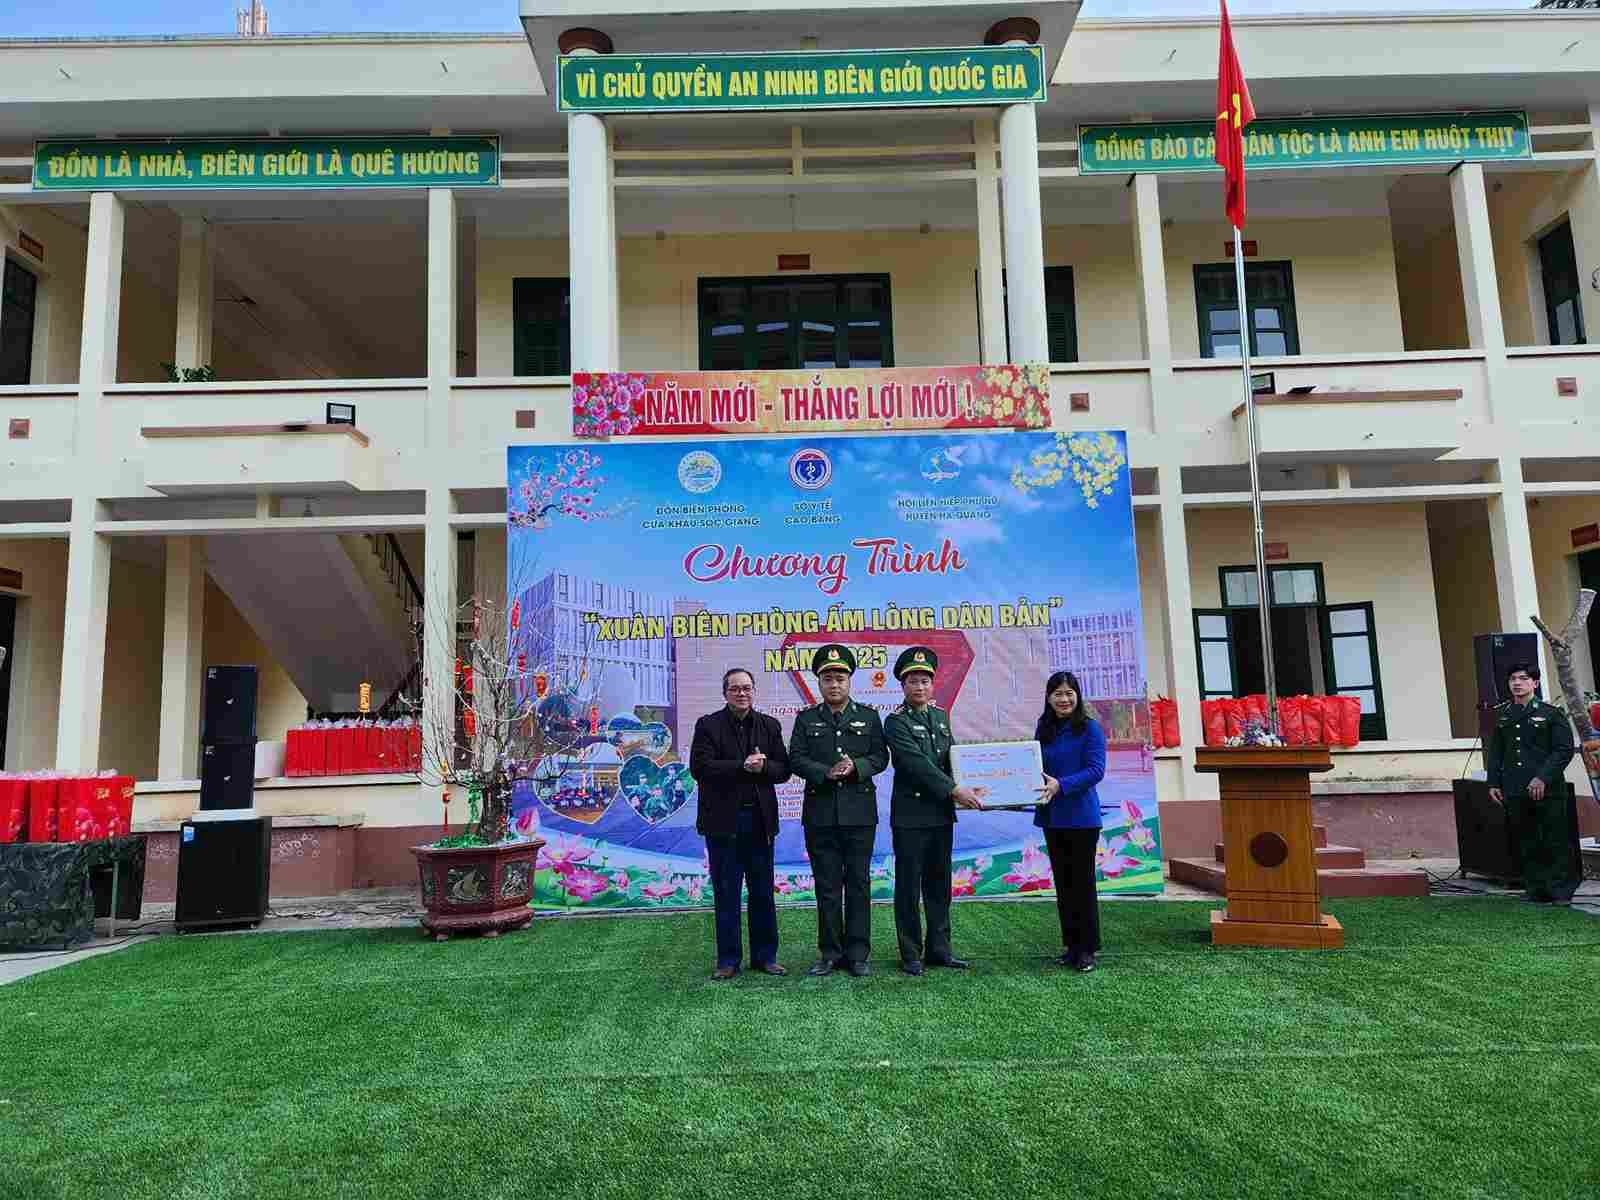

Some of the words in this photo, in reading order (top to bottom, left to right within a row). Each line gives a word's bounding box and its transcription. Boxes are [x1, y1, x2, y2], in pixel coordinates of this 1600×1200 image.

[575, 67, 597, 98] VÌ
[603, 62, 646, 98] CHỦ
[652, 62, 722, 100] QUYỀN
[728, 71, 758, 97] AN
[764, 69, 818, 96] NINH
[824, 63, 874, 95] BIÊN
[880, 58, 923, 93] GIỚI
[929, 56, 986, 95] QUỐC
[992, 64, 1028, 90] GIA
[1095, 132, 1146, 161] ĐỒNG
[1151, 133, 1187, 161] BÀO
[1193, 131, 1217, 160] CÁ
[1279, 128, 1313, 160] TỘC
[1319, 127, 1344, 153] LÀ
[1349, 130, 1385, 153] ANH
[1391, 129, 1419, 151] EM
[1424, 123, 1471, 155] RUỘT
[1475, 127, 1515, 153] THỊT
[48, 148, 98, 178] ĐỒN
[104, 149, 132, 177] LÀ
[139, 149, 193, 180] NHÀ,
[201, 148, 256, 177] BIÊN
[262, 148, 308, 176] GIỚI
[316, 147, 344, 176] LÀ
[351, 148, 395, 177] QUÊ
[402, 149, 480, 175] HƯƠNG
[645, 379, 704, 425] NĂM
[711, 380, 757, 424] MỚI
[780, 371, 860, 422] THẮNG
[866, 380, 903, 428] LỢI
[911, 376, 960, 419] MỚI
[684, 543, 849, 595] Chương
[852, 537, 967, 576] Trình
[671, 608, 730, 638] BIÊN
[735, 606, 819, 636] PHÒNG
[826, 600, 865, 632] ẤM
[871, 599, 937, 631] LÒNG
[942, 601, 993, 629] DÂN
[764, 644, 817, 672] NĂM
